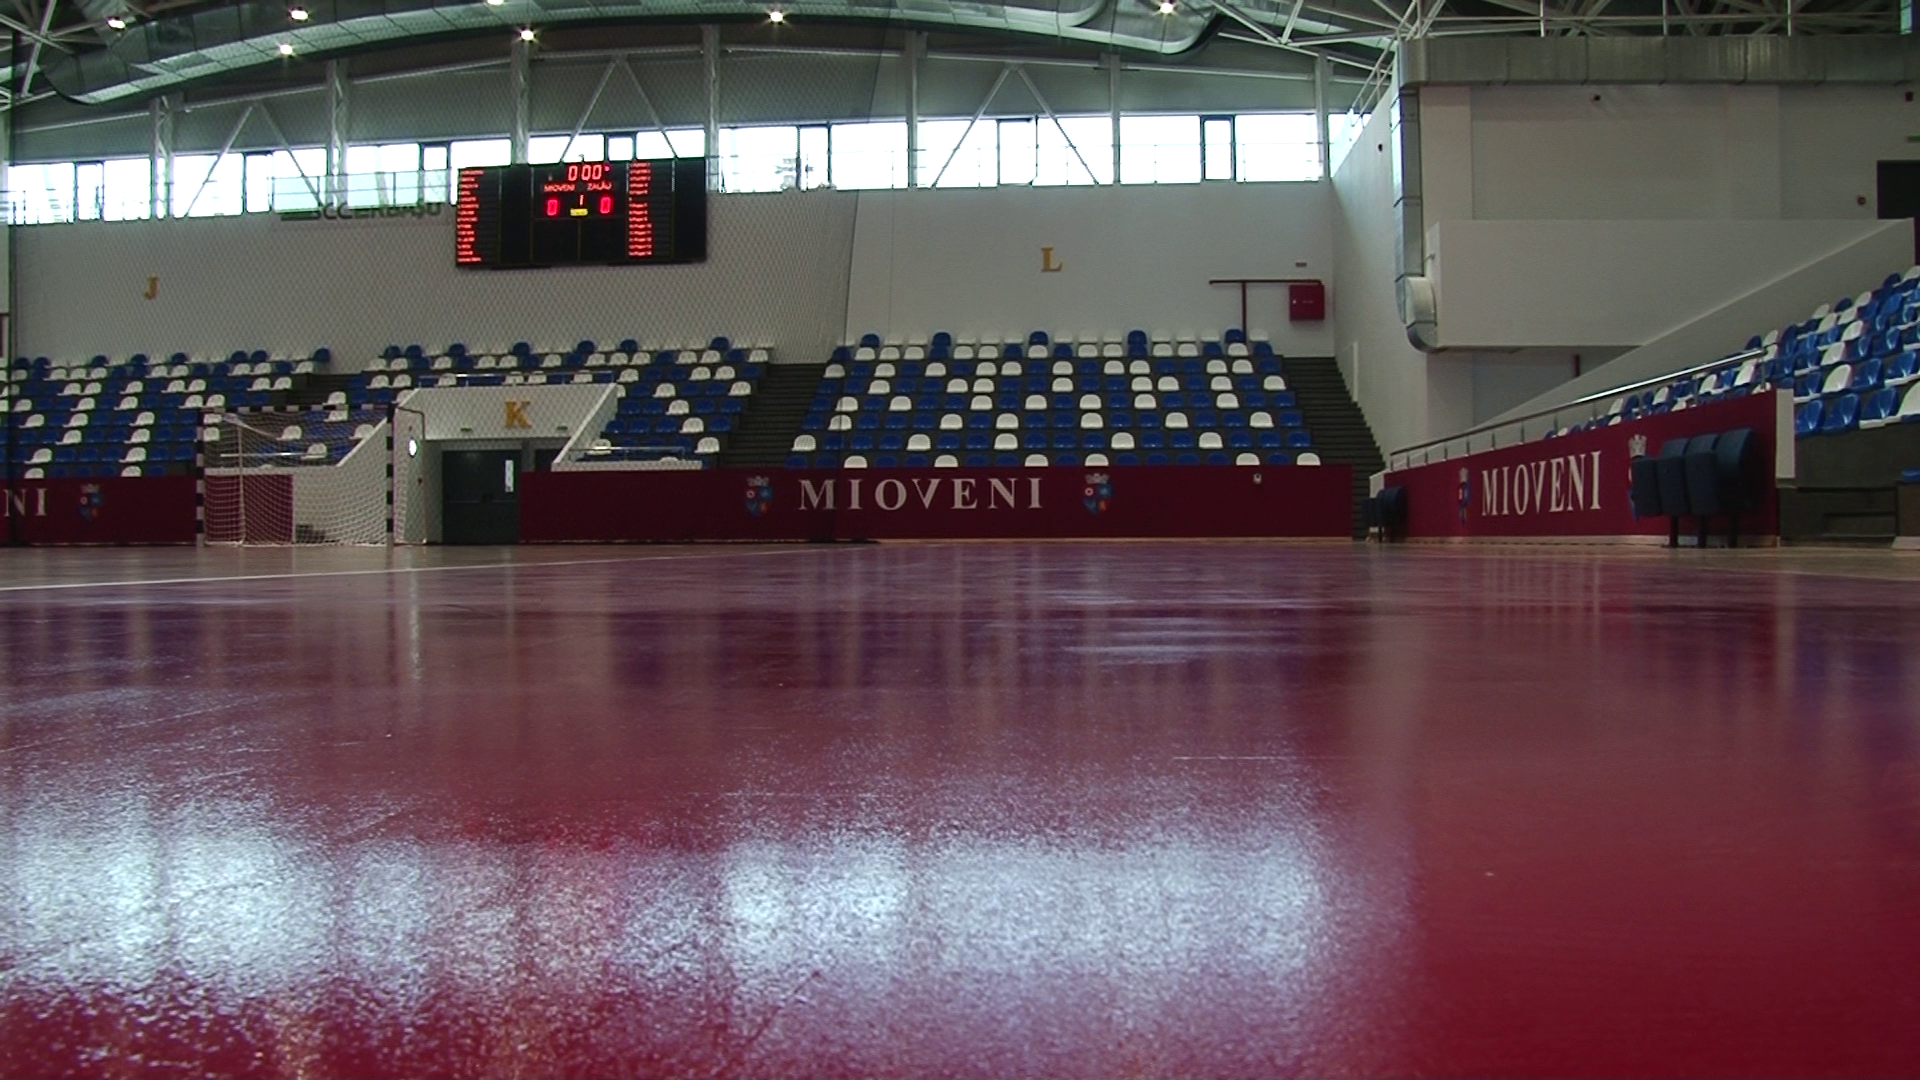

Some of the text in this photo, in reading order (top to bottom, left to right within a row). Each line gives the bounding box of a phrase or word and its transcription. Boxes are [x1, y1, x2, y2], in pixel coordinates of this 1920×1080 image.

[546, 199, 558, 216] 0
[600, 196, 612, 214] 0
[1041, 246, 1064, 273] L
[144, 275, 158, 300] J
[503, 399, 533, 430] K
[798, 478, 1043, 510] MIOVENI
[1481, 450, 1602, 517] MIOVENI
